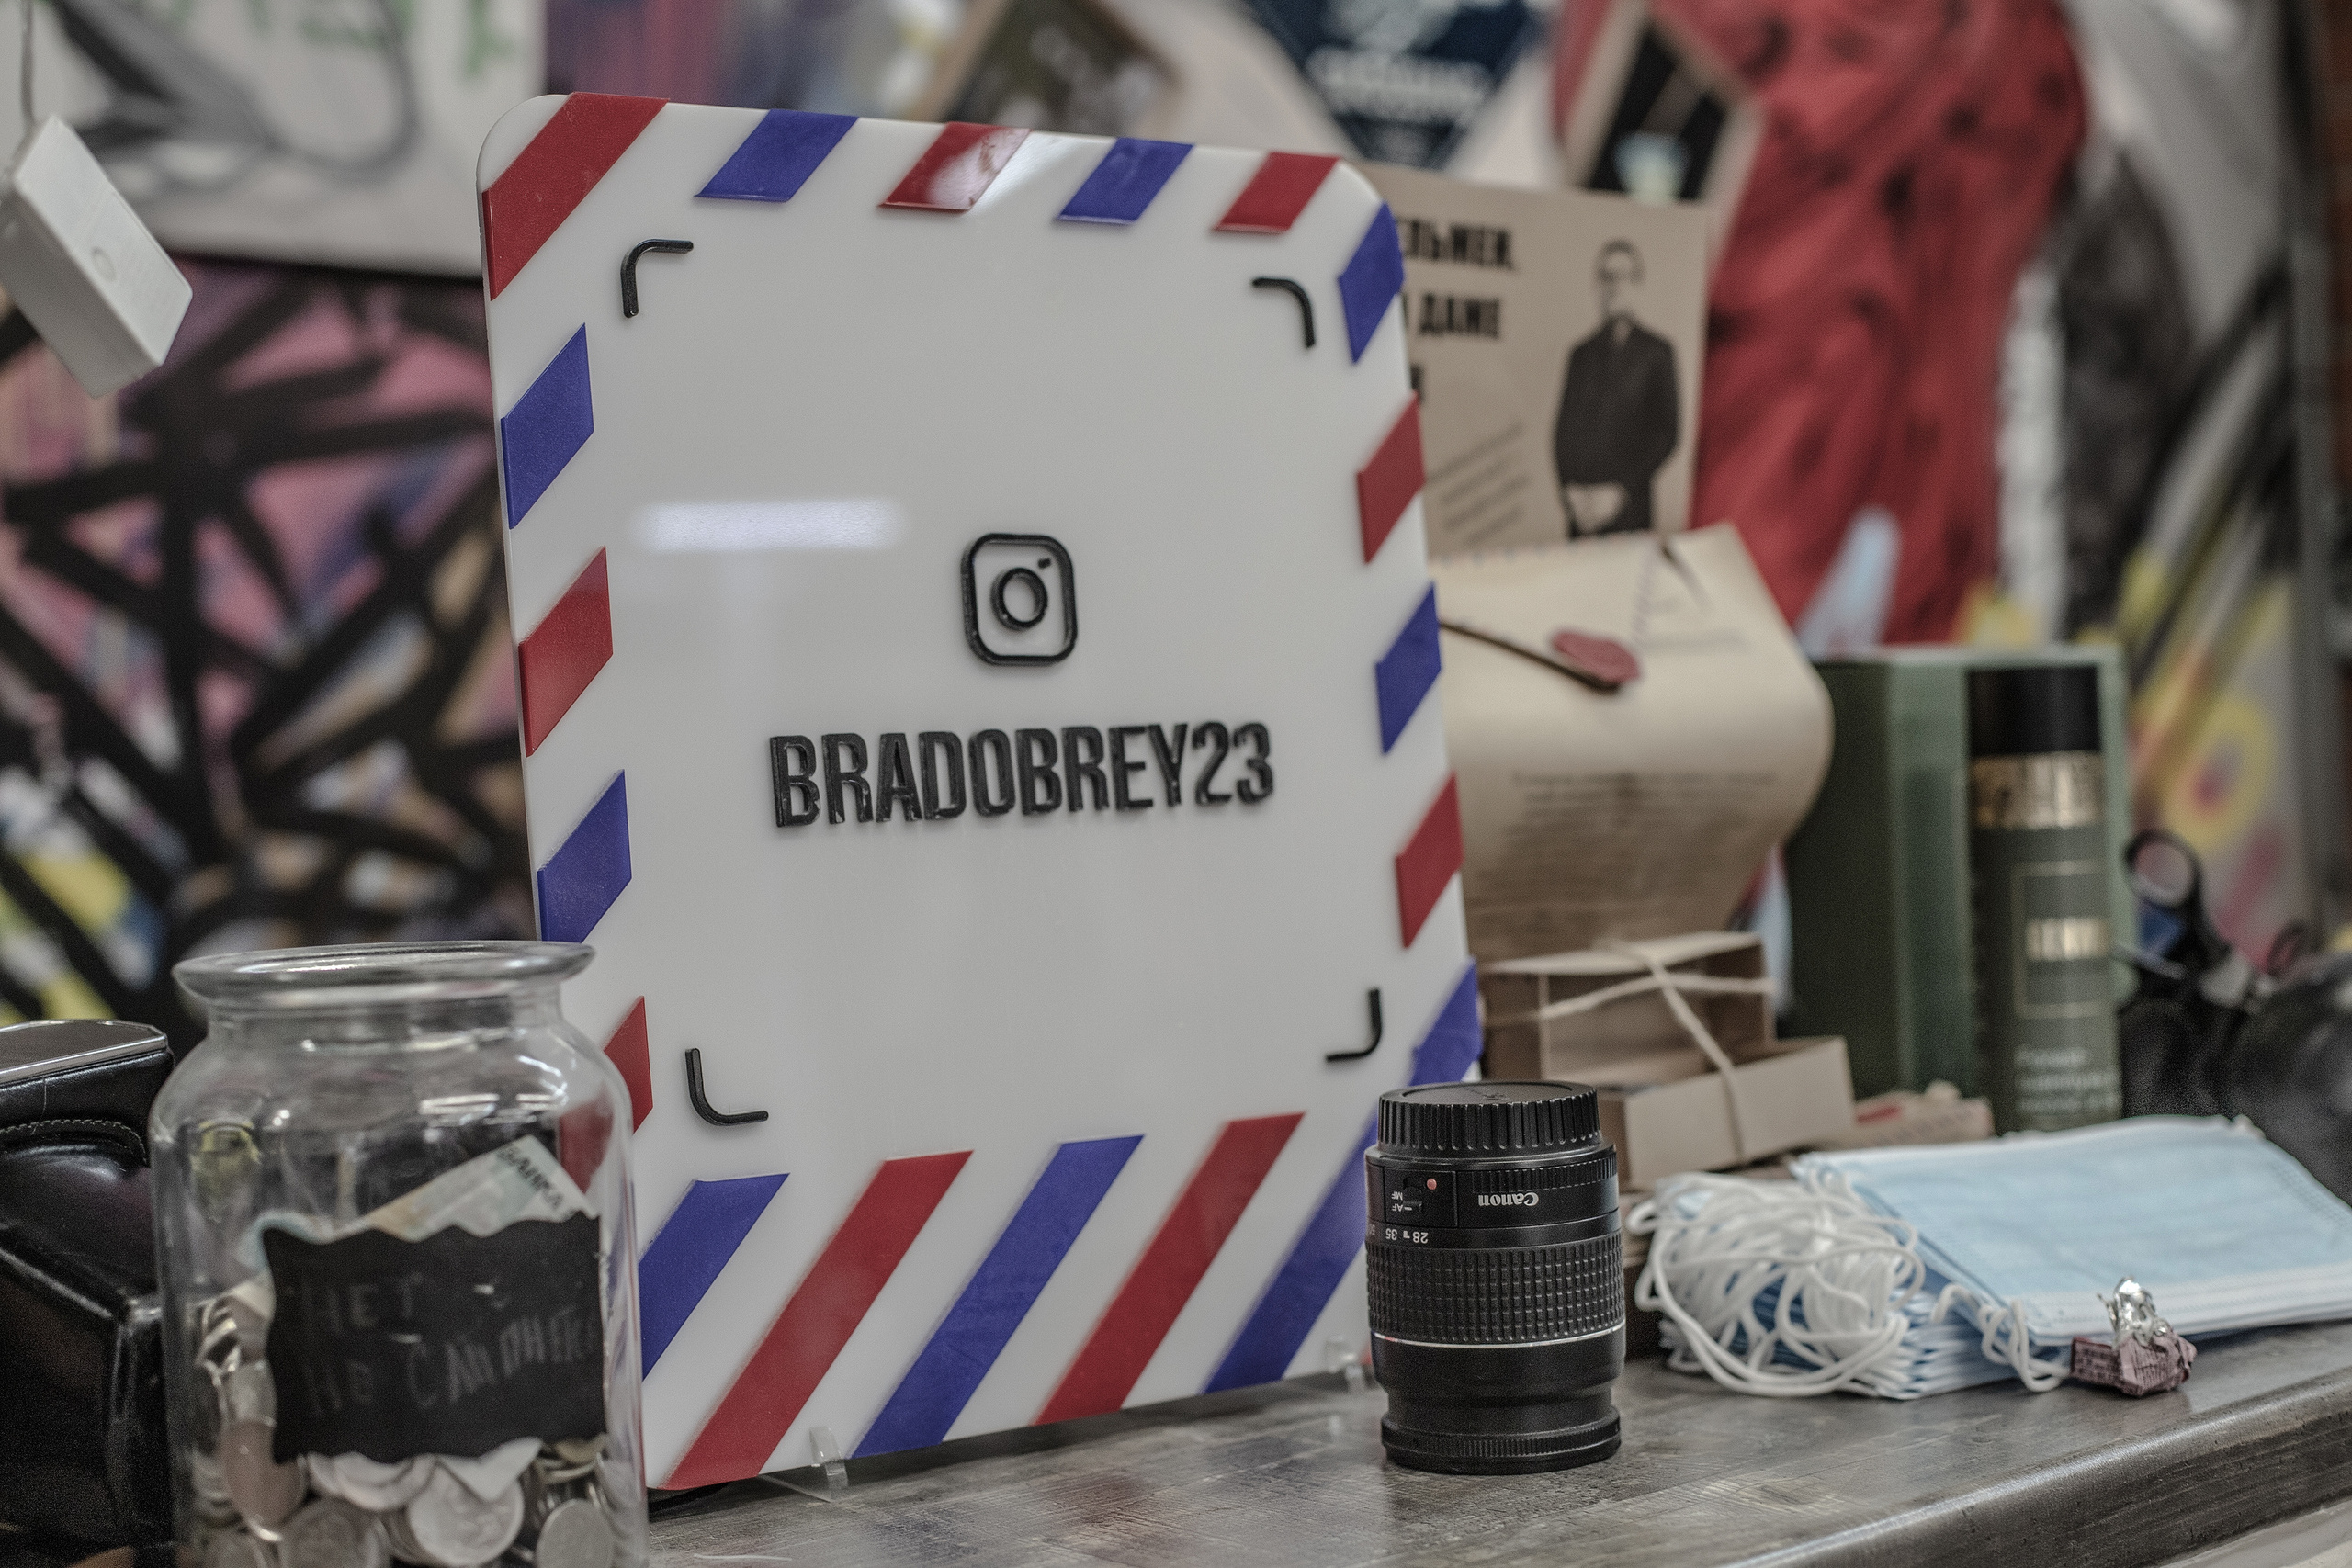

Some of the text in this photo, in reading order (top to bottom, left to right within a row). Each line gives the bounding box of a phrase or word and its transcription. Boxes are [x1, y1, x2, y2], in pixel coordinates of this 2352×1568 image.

[770, 721, 1273, 828] BRADOBREY23
[1391, 1190, 1404, 1201] MF
[1477, 1191, 1540, 1208] Canon
[1391, 1203, 1404, 1213] AF
[1385, 1227, 1398, 1241] 35
[1412, 1231, 1429, 1244] 28
